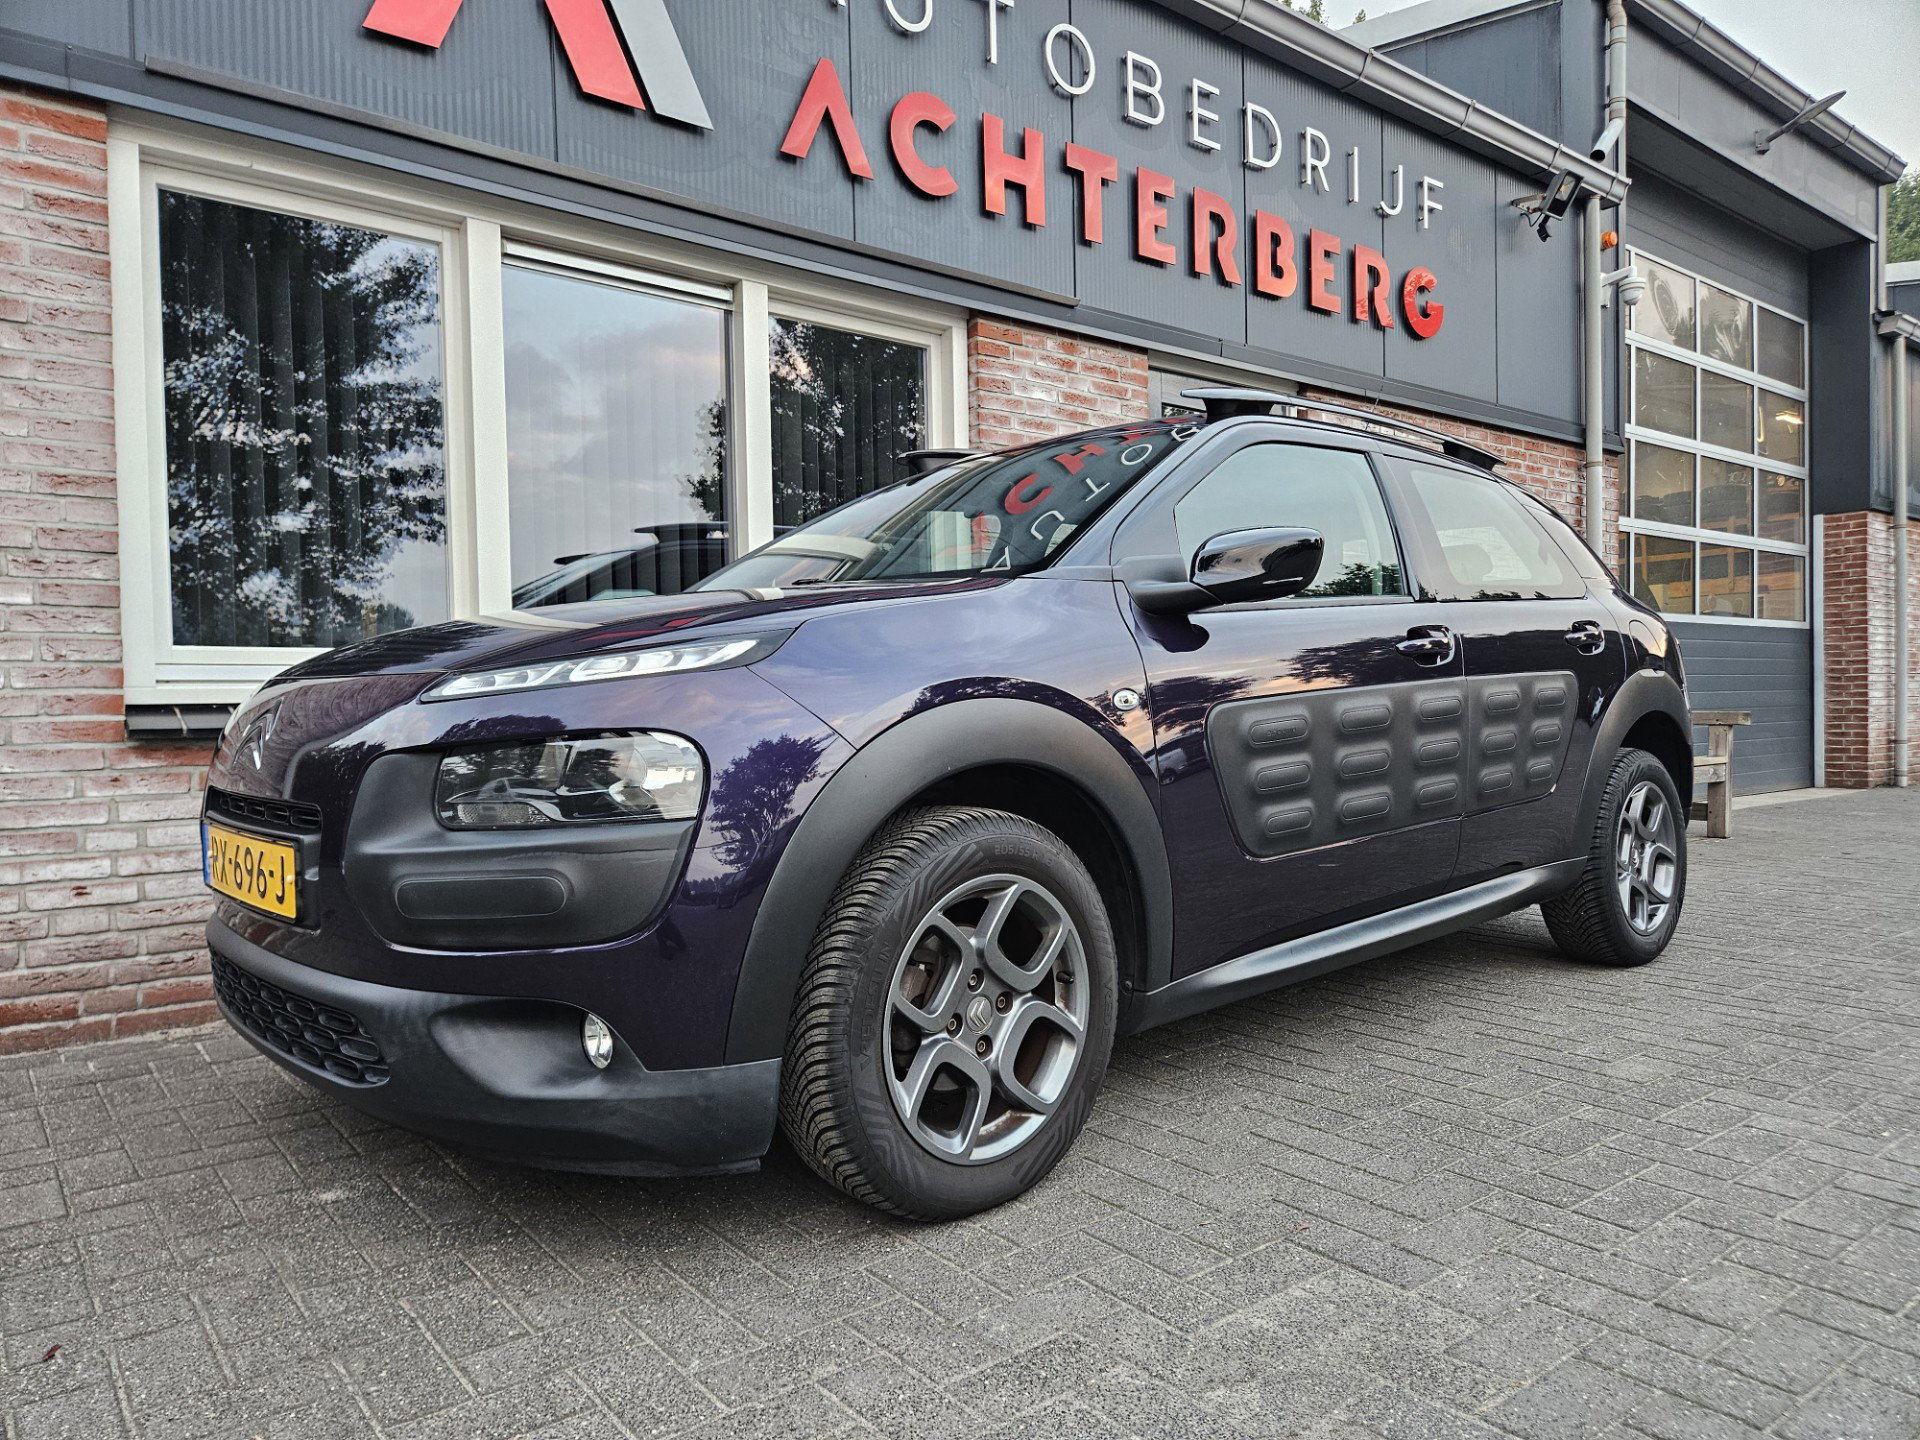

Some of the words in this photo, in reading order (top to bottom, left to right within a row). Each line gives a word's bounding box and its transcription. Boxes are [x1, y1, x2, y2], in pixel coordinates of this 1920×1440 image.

[780, 57, 1444, 338] ACHTERBERG
[836, 0, 1444, 229] TOBEDRIJF
[211, 835, 286, 905] RX-696-J
